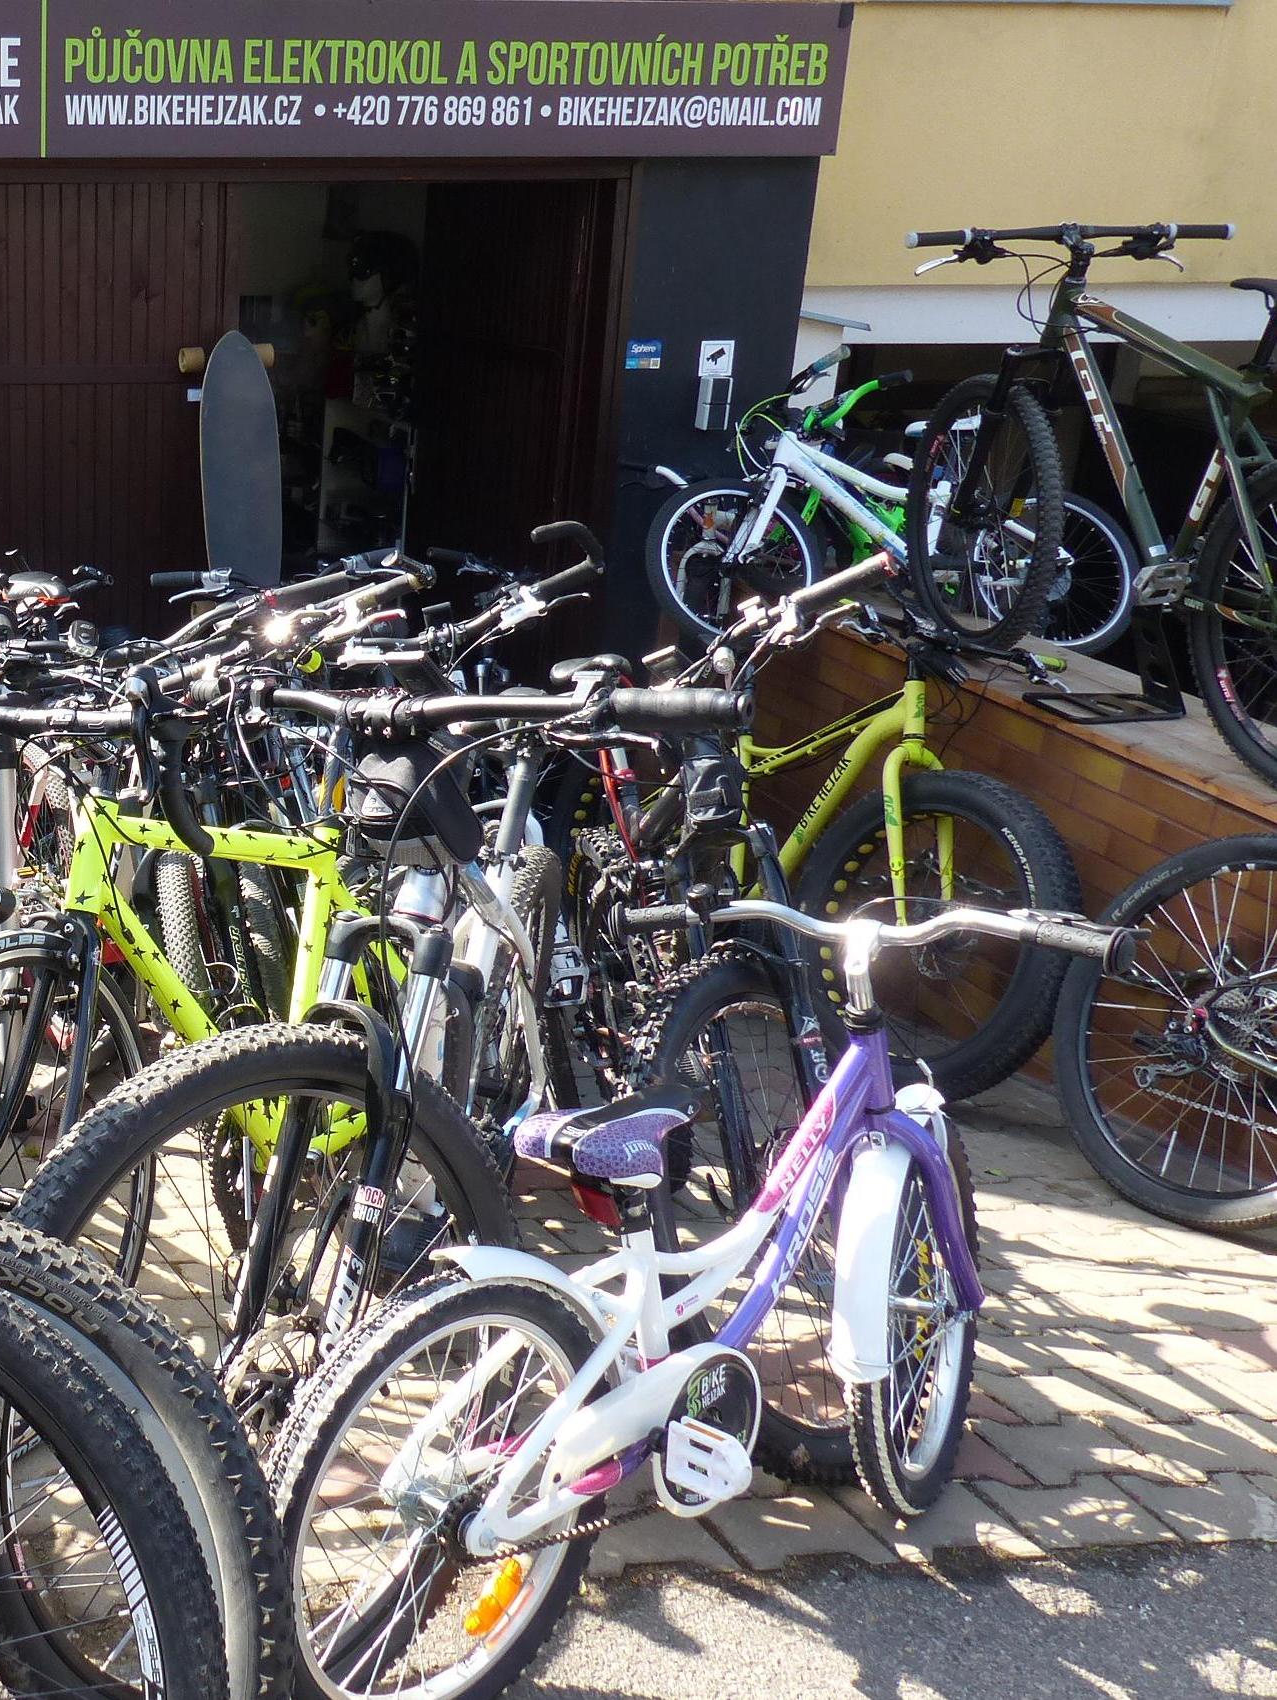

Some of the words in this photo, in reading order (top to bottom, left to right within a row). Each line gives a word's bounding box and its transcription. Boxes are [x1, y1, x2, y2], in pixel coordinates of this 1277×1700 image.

[65, 27, 233, 85] PŮJČOVNA
[243, 38, 448, 86] ELEKTROKOL
[456, 39, 478, 85] A
[486, 33, 703, 86] SPORTOVNÍCH
[710, 34, 829, 86] POTŘEB
[65, 94, 302, 127] WWW.BIKEHEJZAK.CZ
[333, 95, 390, 127] +420
[397, 95, 438, 127] 776
[443, 95, 485, 127] 869
[491, 95, 533, 127] 861
[558, 94, 822, 127] BIKEHEJZAK@GMAIL.COM
[631, 343, 657, 354] Sphere
[623, 1139, 659, 1162] junio
[778, 1113, 829, 1192] NELLY
[352, 1202, 381, 1225] SHOX
[772, 1147, 835, 1297] KROSS
